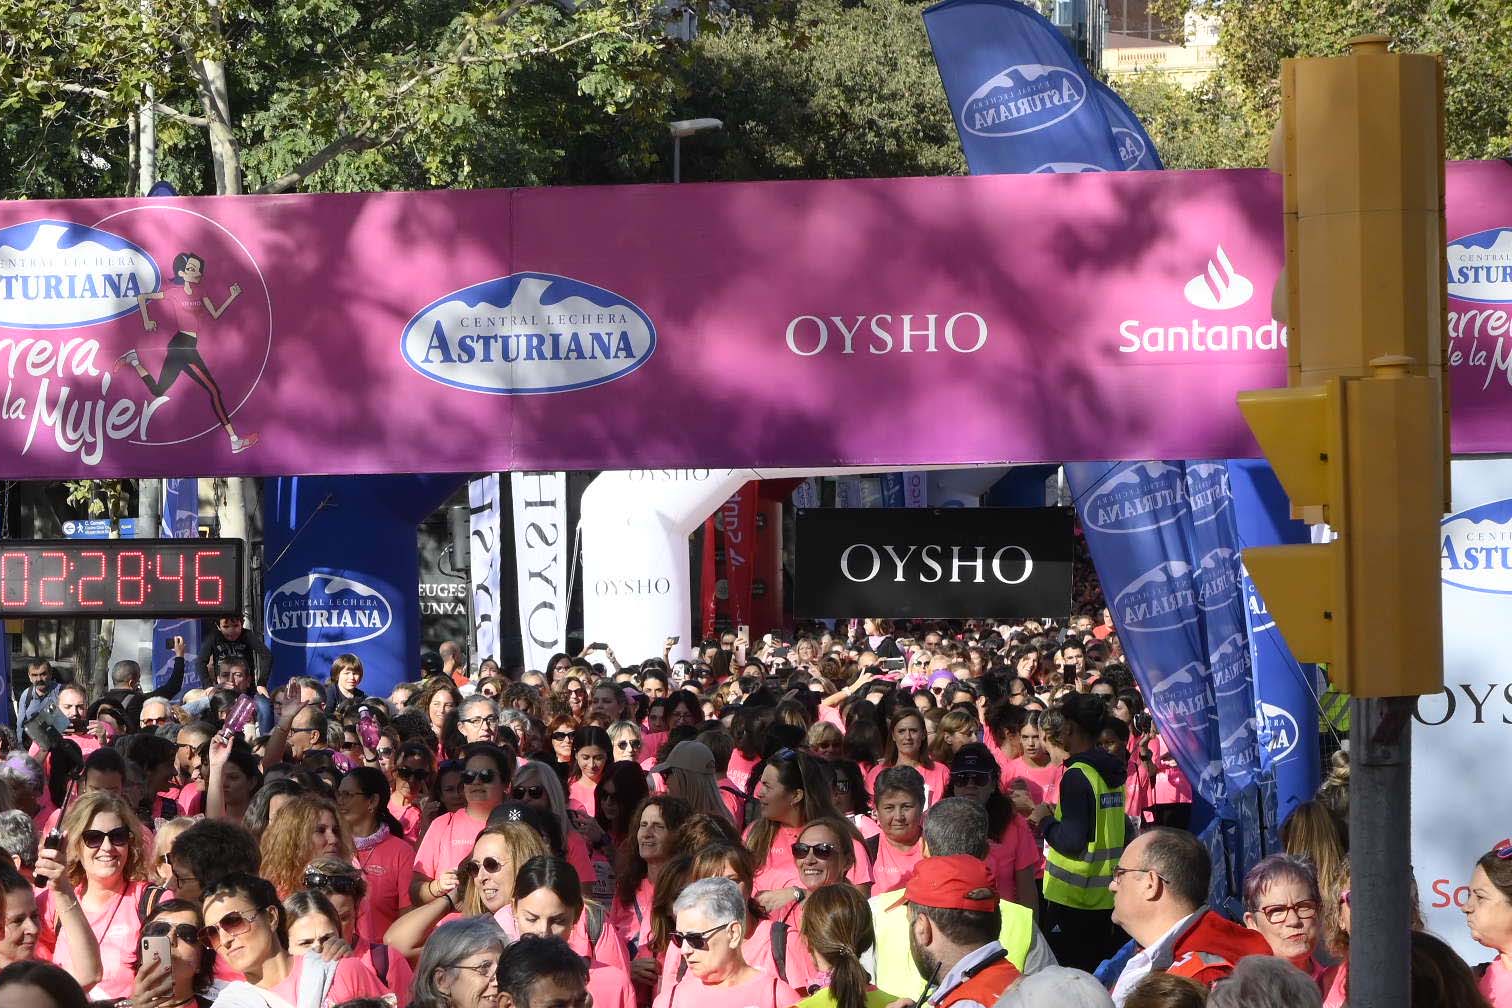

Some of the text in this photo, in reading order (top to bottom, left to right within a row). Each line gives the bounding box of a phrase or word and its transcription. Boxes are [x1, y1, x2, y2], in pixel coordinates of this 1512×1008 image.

[460, 312, 629, 328] CENTRAL LECHERA
[786, 312, 988, 356] OYSHO
[421, 319, 636, 364] ASTURIANA
[1119, 319, 1288, 352] Santande
[1469, 338, 1486, 366] la
[2, 379, 26, 420] la
[21, 370, 170, 466] Mujer
[1466, 531, 1512, 542] CENT
[840, 543, 1033, 584] OYSHO
[1441, 535, 1512, 571] ASTU
[0, 551, 223, 607] 02:28:46
[419, 584, 466, 597] EUGES
[595, 577, 671, 596] OYSHO
[270, 603, 382, 631] ASTURIANA
[328, 598, 378, 606] LECHERA
[421, 603, 466, 615] UNYA
